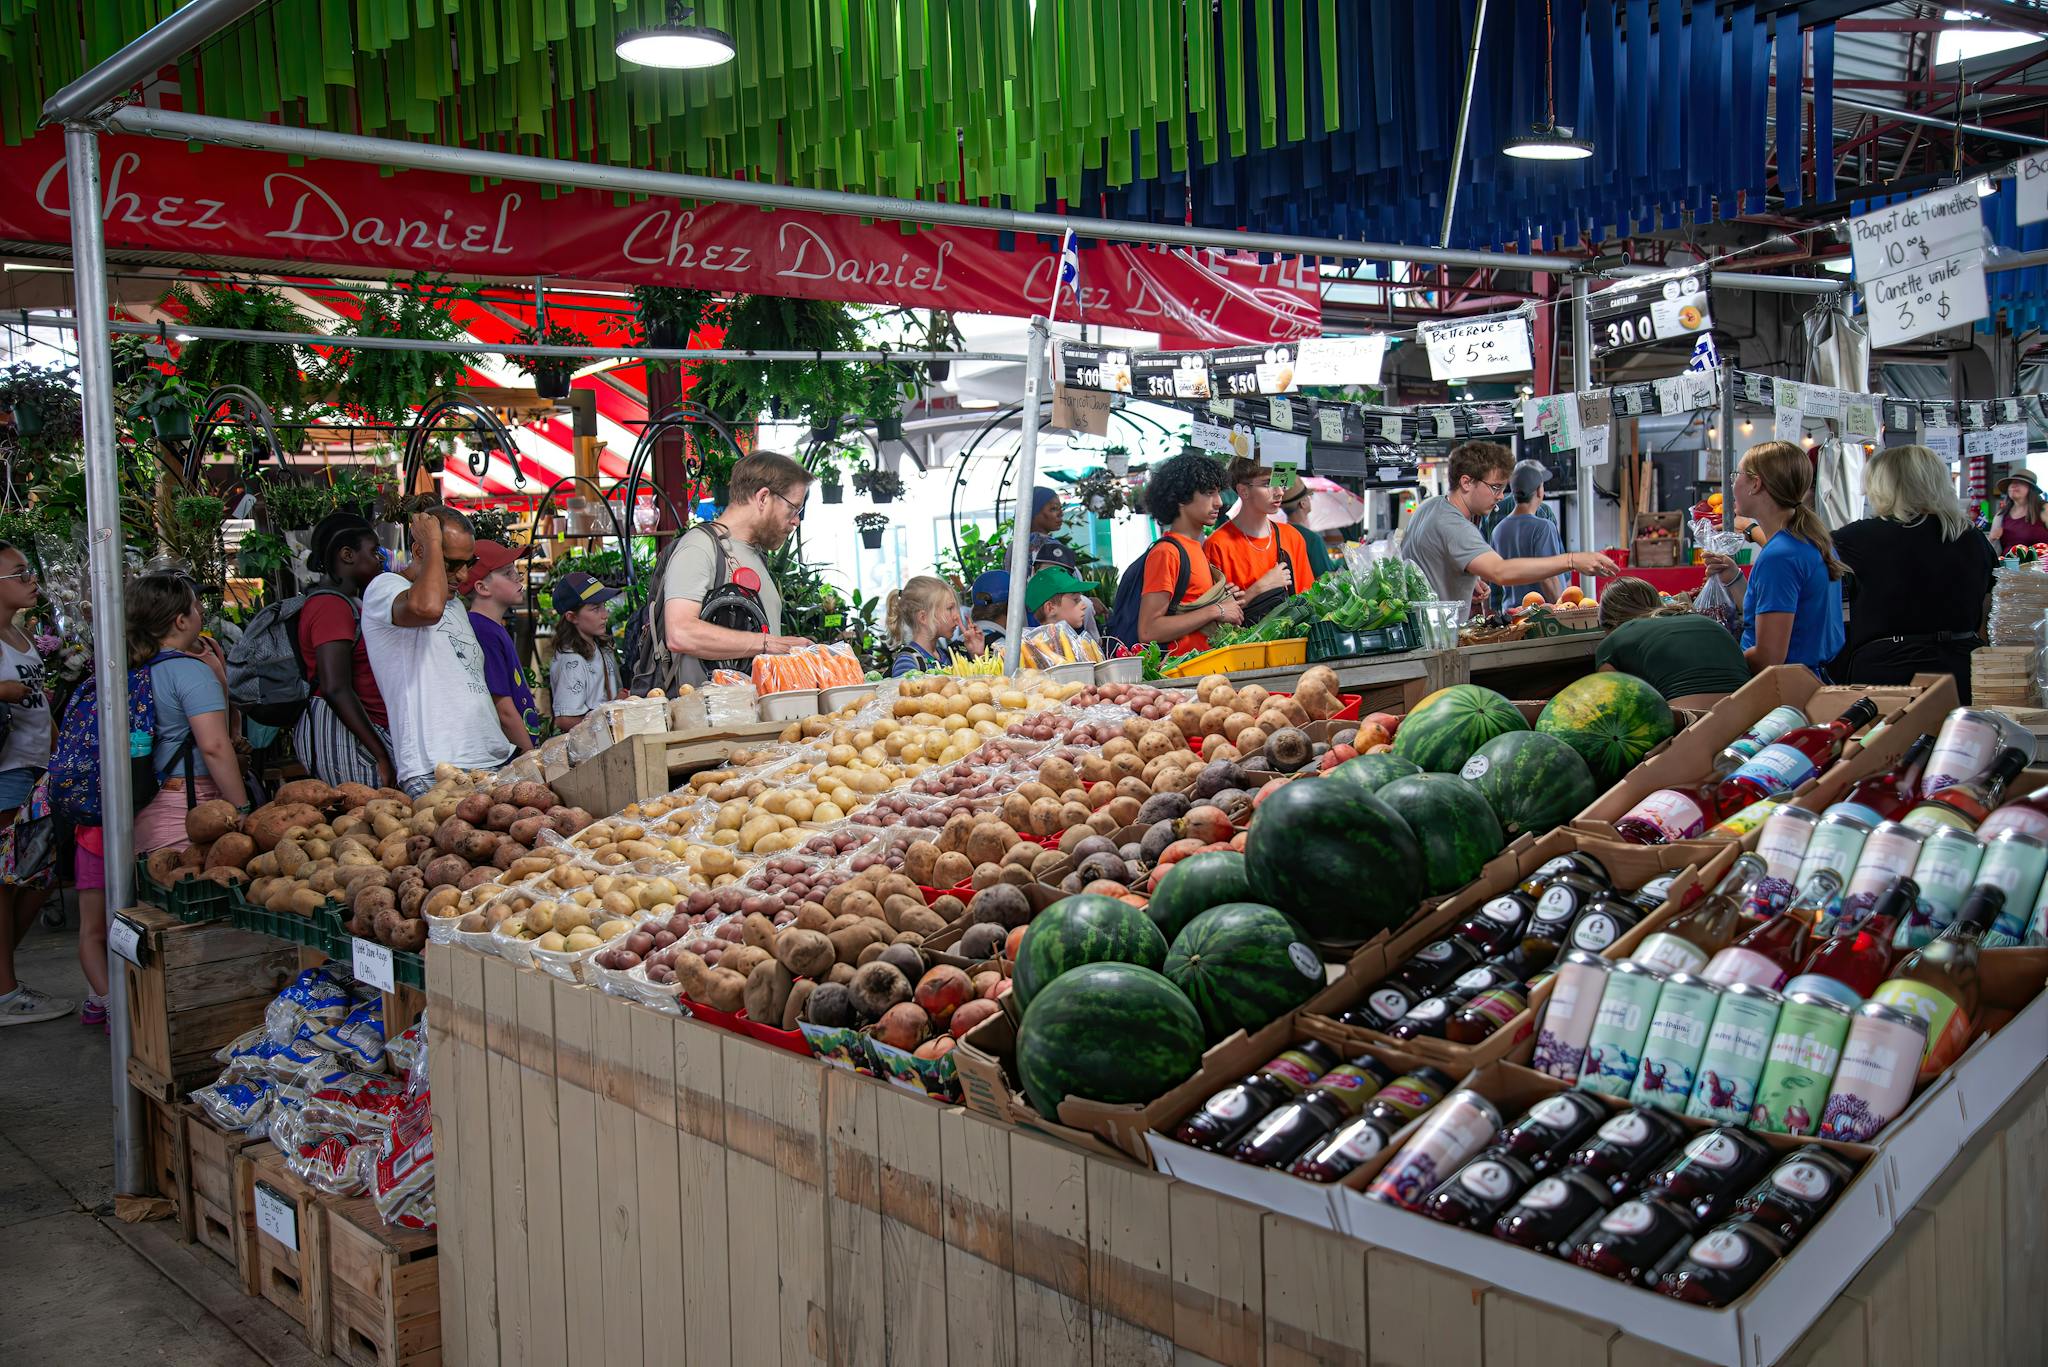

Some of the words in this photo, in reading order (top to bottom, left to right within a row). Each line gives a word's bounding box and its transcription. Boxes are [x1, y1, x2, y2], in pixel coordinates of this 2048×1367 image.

[36, 152, 227, 232] Chez
[263, 172, 522, 256] Daniel
[1853, 212, 1899, 242] Paquet
[1901, 208, 1918, 228] de
[623, 209, 752, 275] Chez
[778, 220, 954, 294] Daniel
[1875, 273, 1924, 305] Canette
[1432, 321, 1505, 342] BETTERAVES
